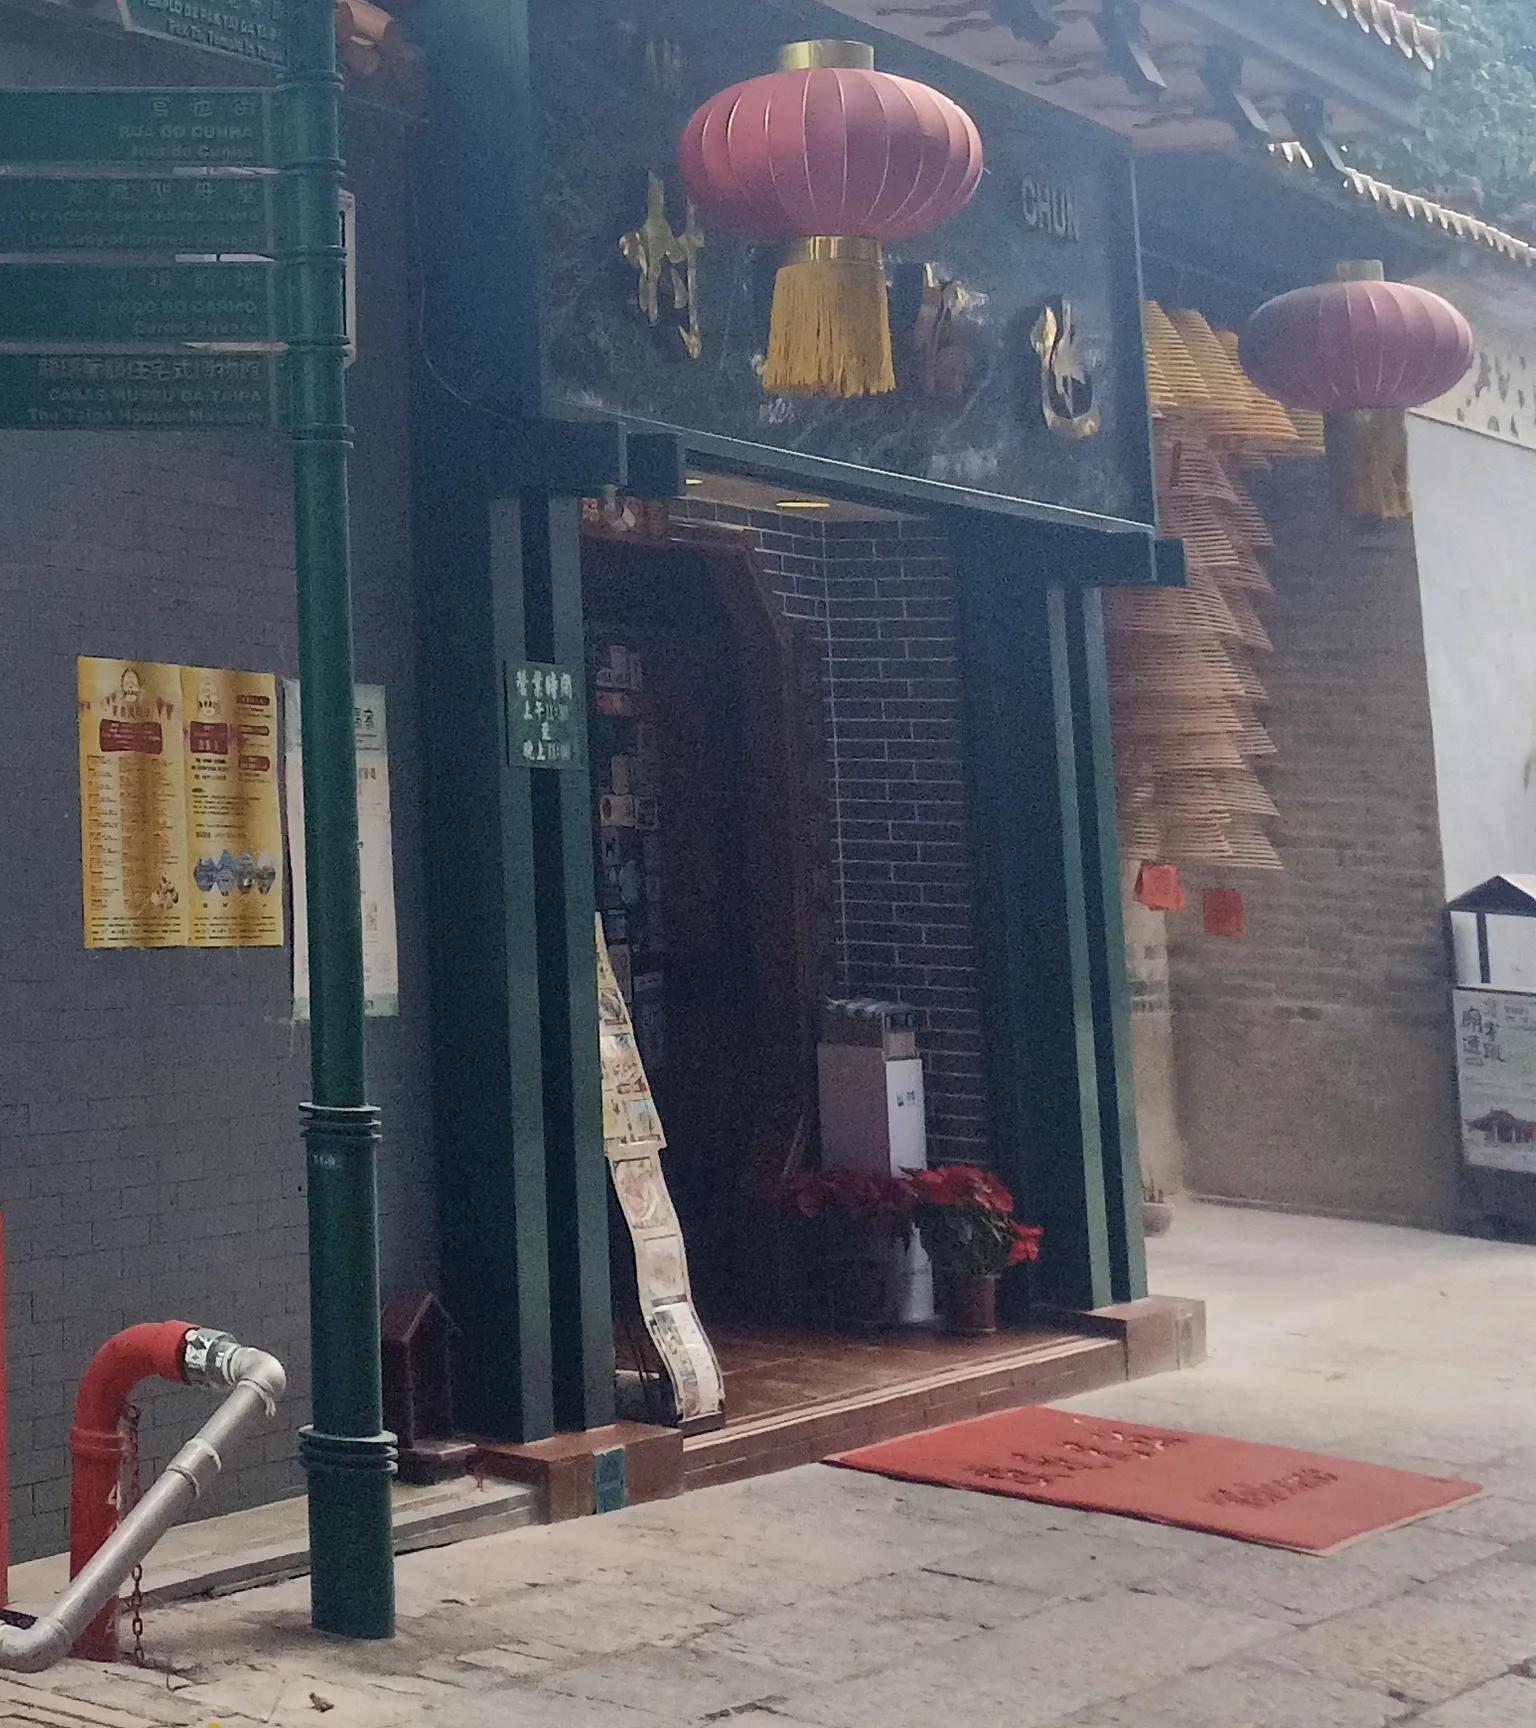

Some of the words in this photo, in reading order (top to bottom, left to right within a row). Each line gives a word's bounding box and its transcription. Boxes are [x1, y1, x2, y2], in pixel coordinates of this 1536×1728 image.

[118, 126, 154, 139] RUA
[161, 126, 186, 139] DO
[191, 126, 254, 139] CUNHA
[1020, 174, 1081, 242] CHUN
